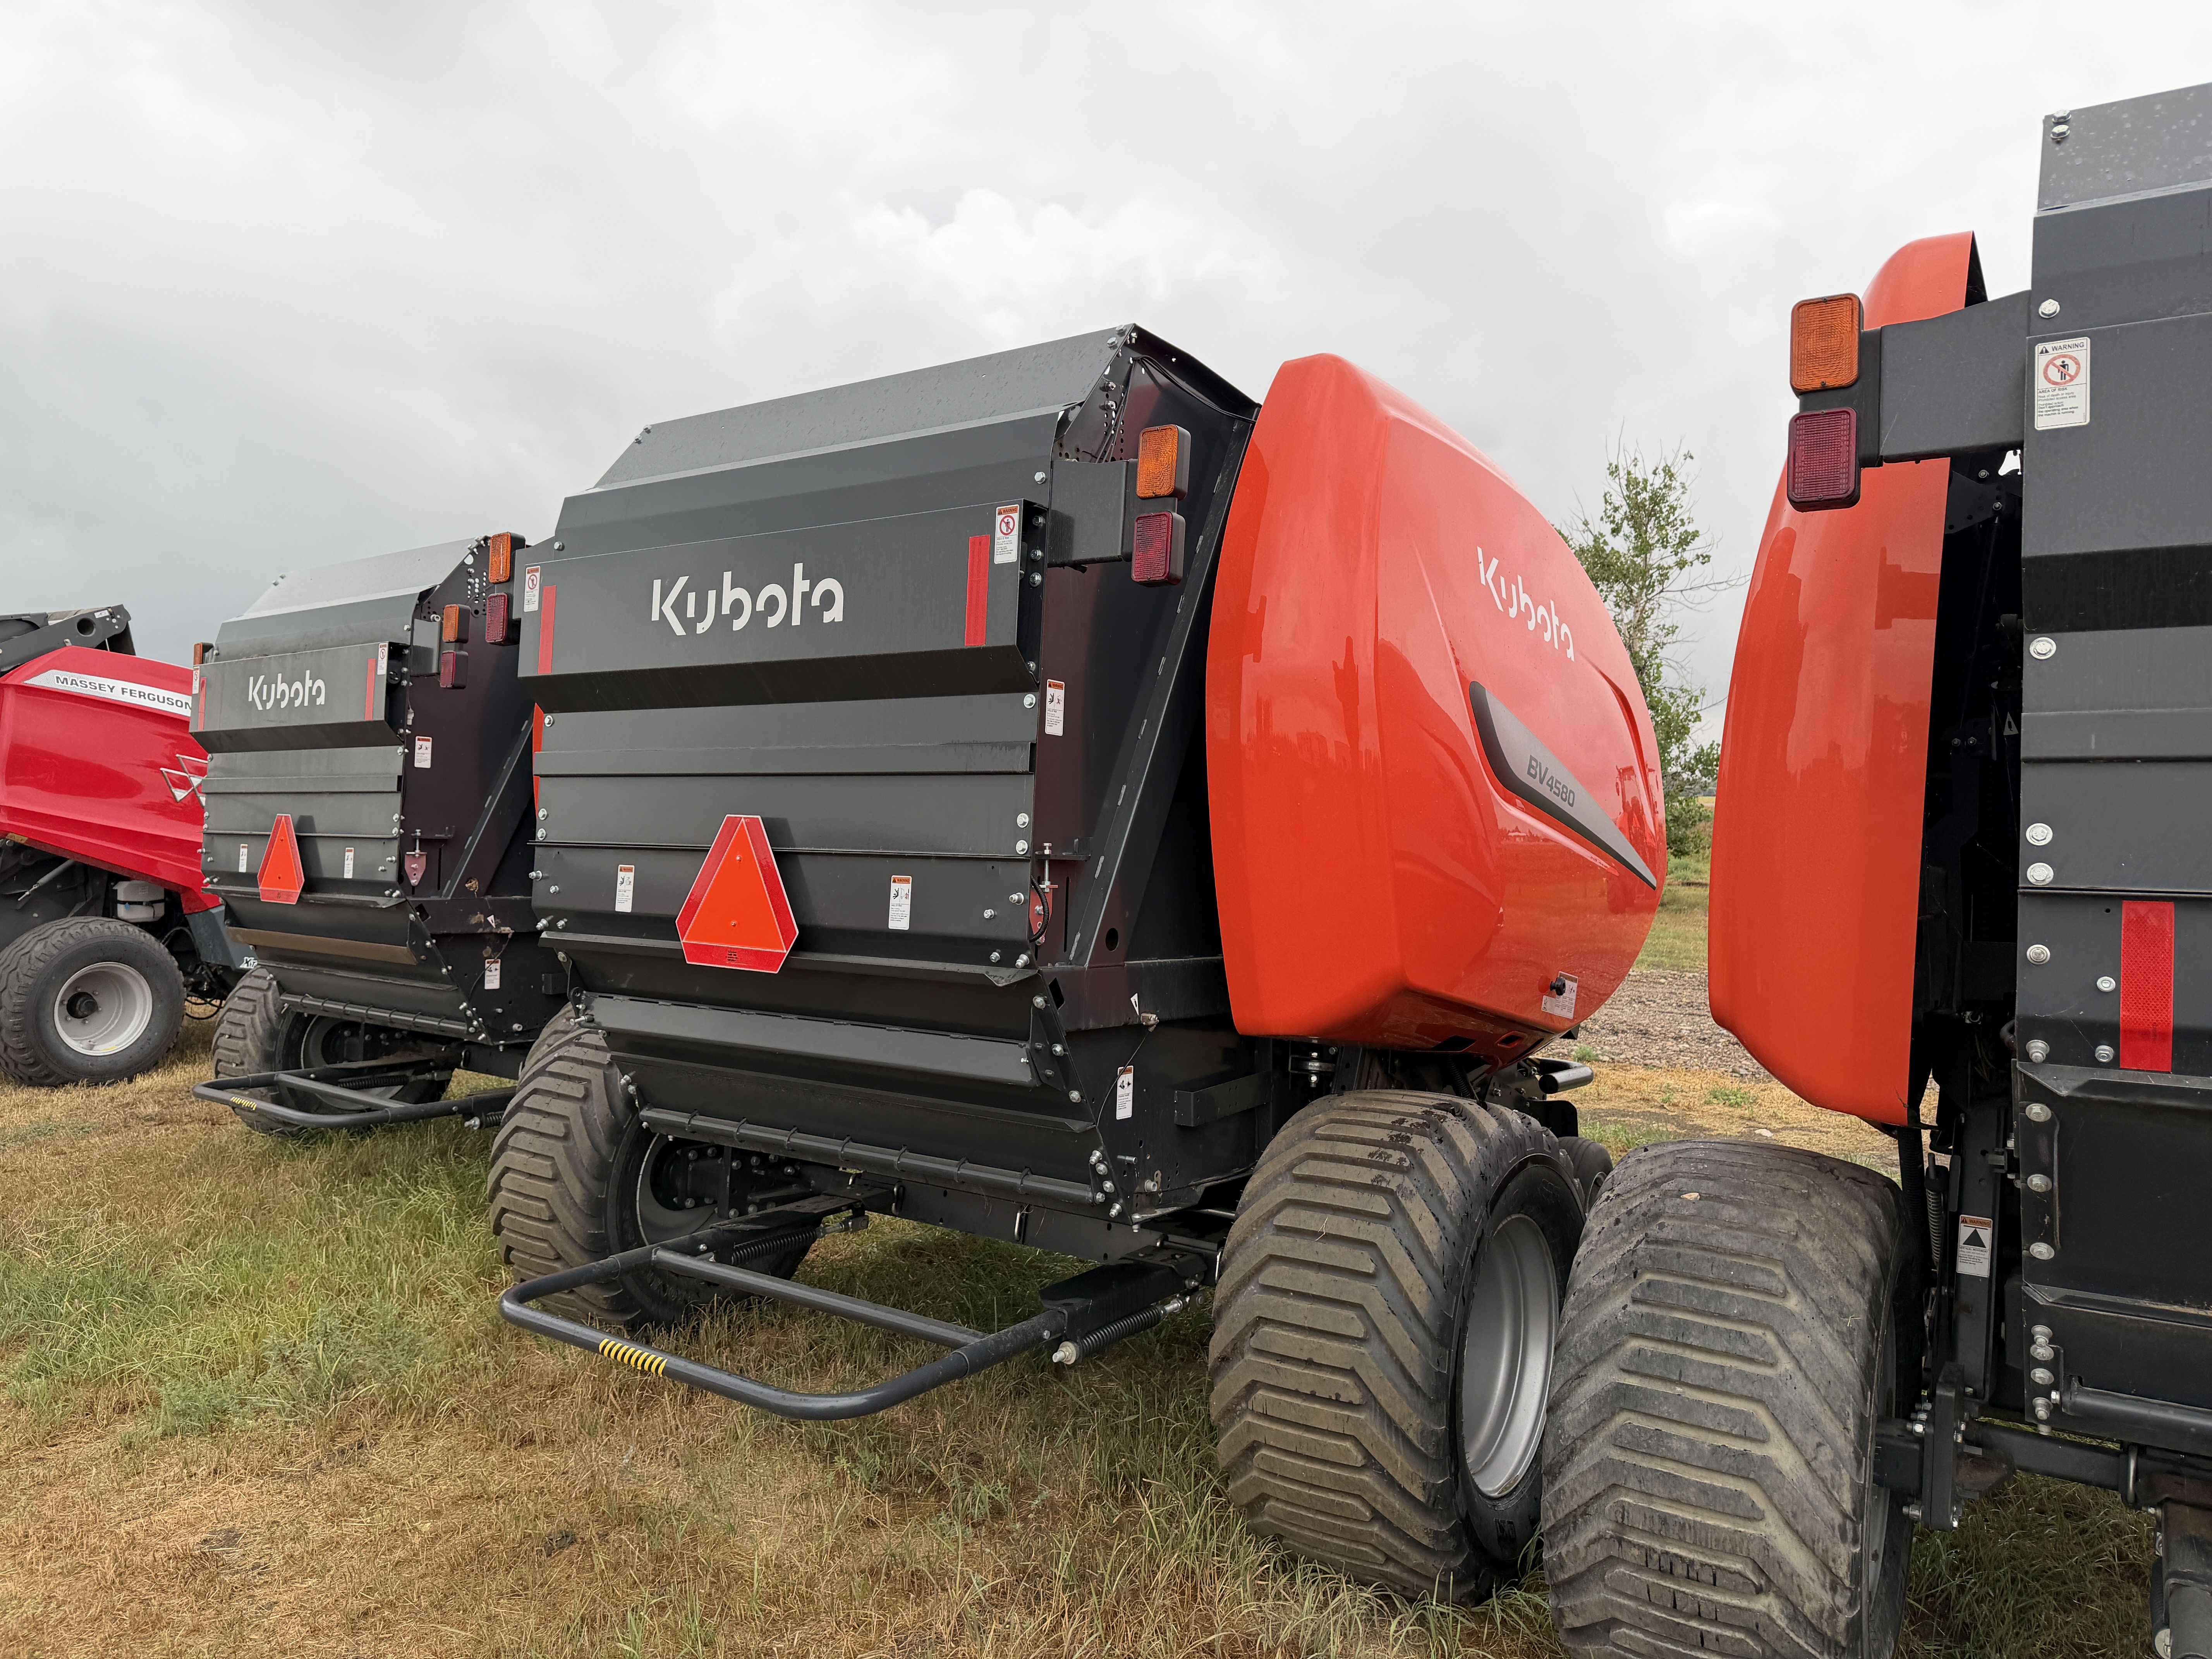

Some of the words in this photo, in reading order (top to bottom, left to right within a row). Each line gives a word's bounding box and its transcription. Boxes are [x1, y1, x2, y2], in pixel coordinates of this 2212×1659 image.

[2052, 342, 2084, 351] WARNING
[651, 563, 844, 635] Kubota
[1477, 546, 1575, 662] Kubota
[55, 676, 115, 693] MASSEY
[121, 687, 192, 710] FERGUSON
[248, 670, 325, 711] Kubota
[1527, 754, 1575, 807] BV4580
